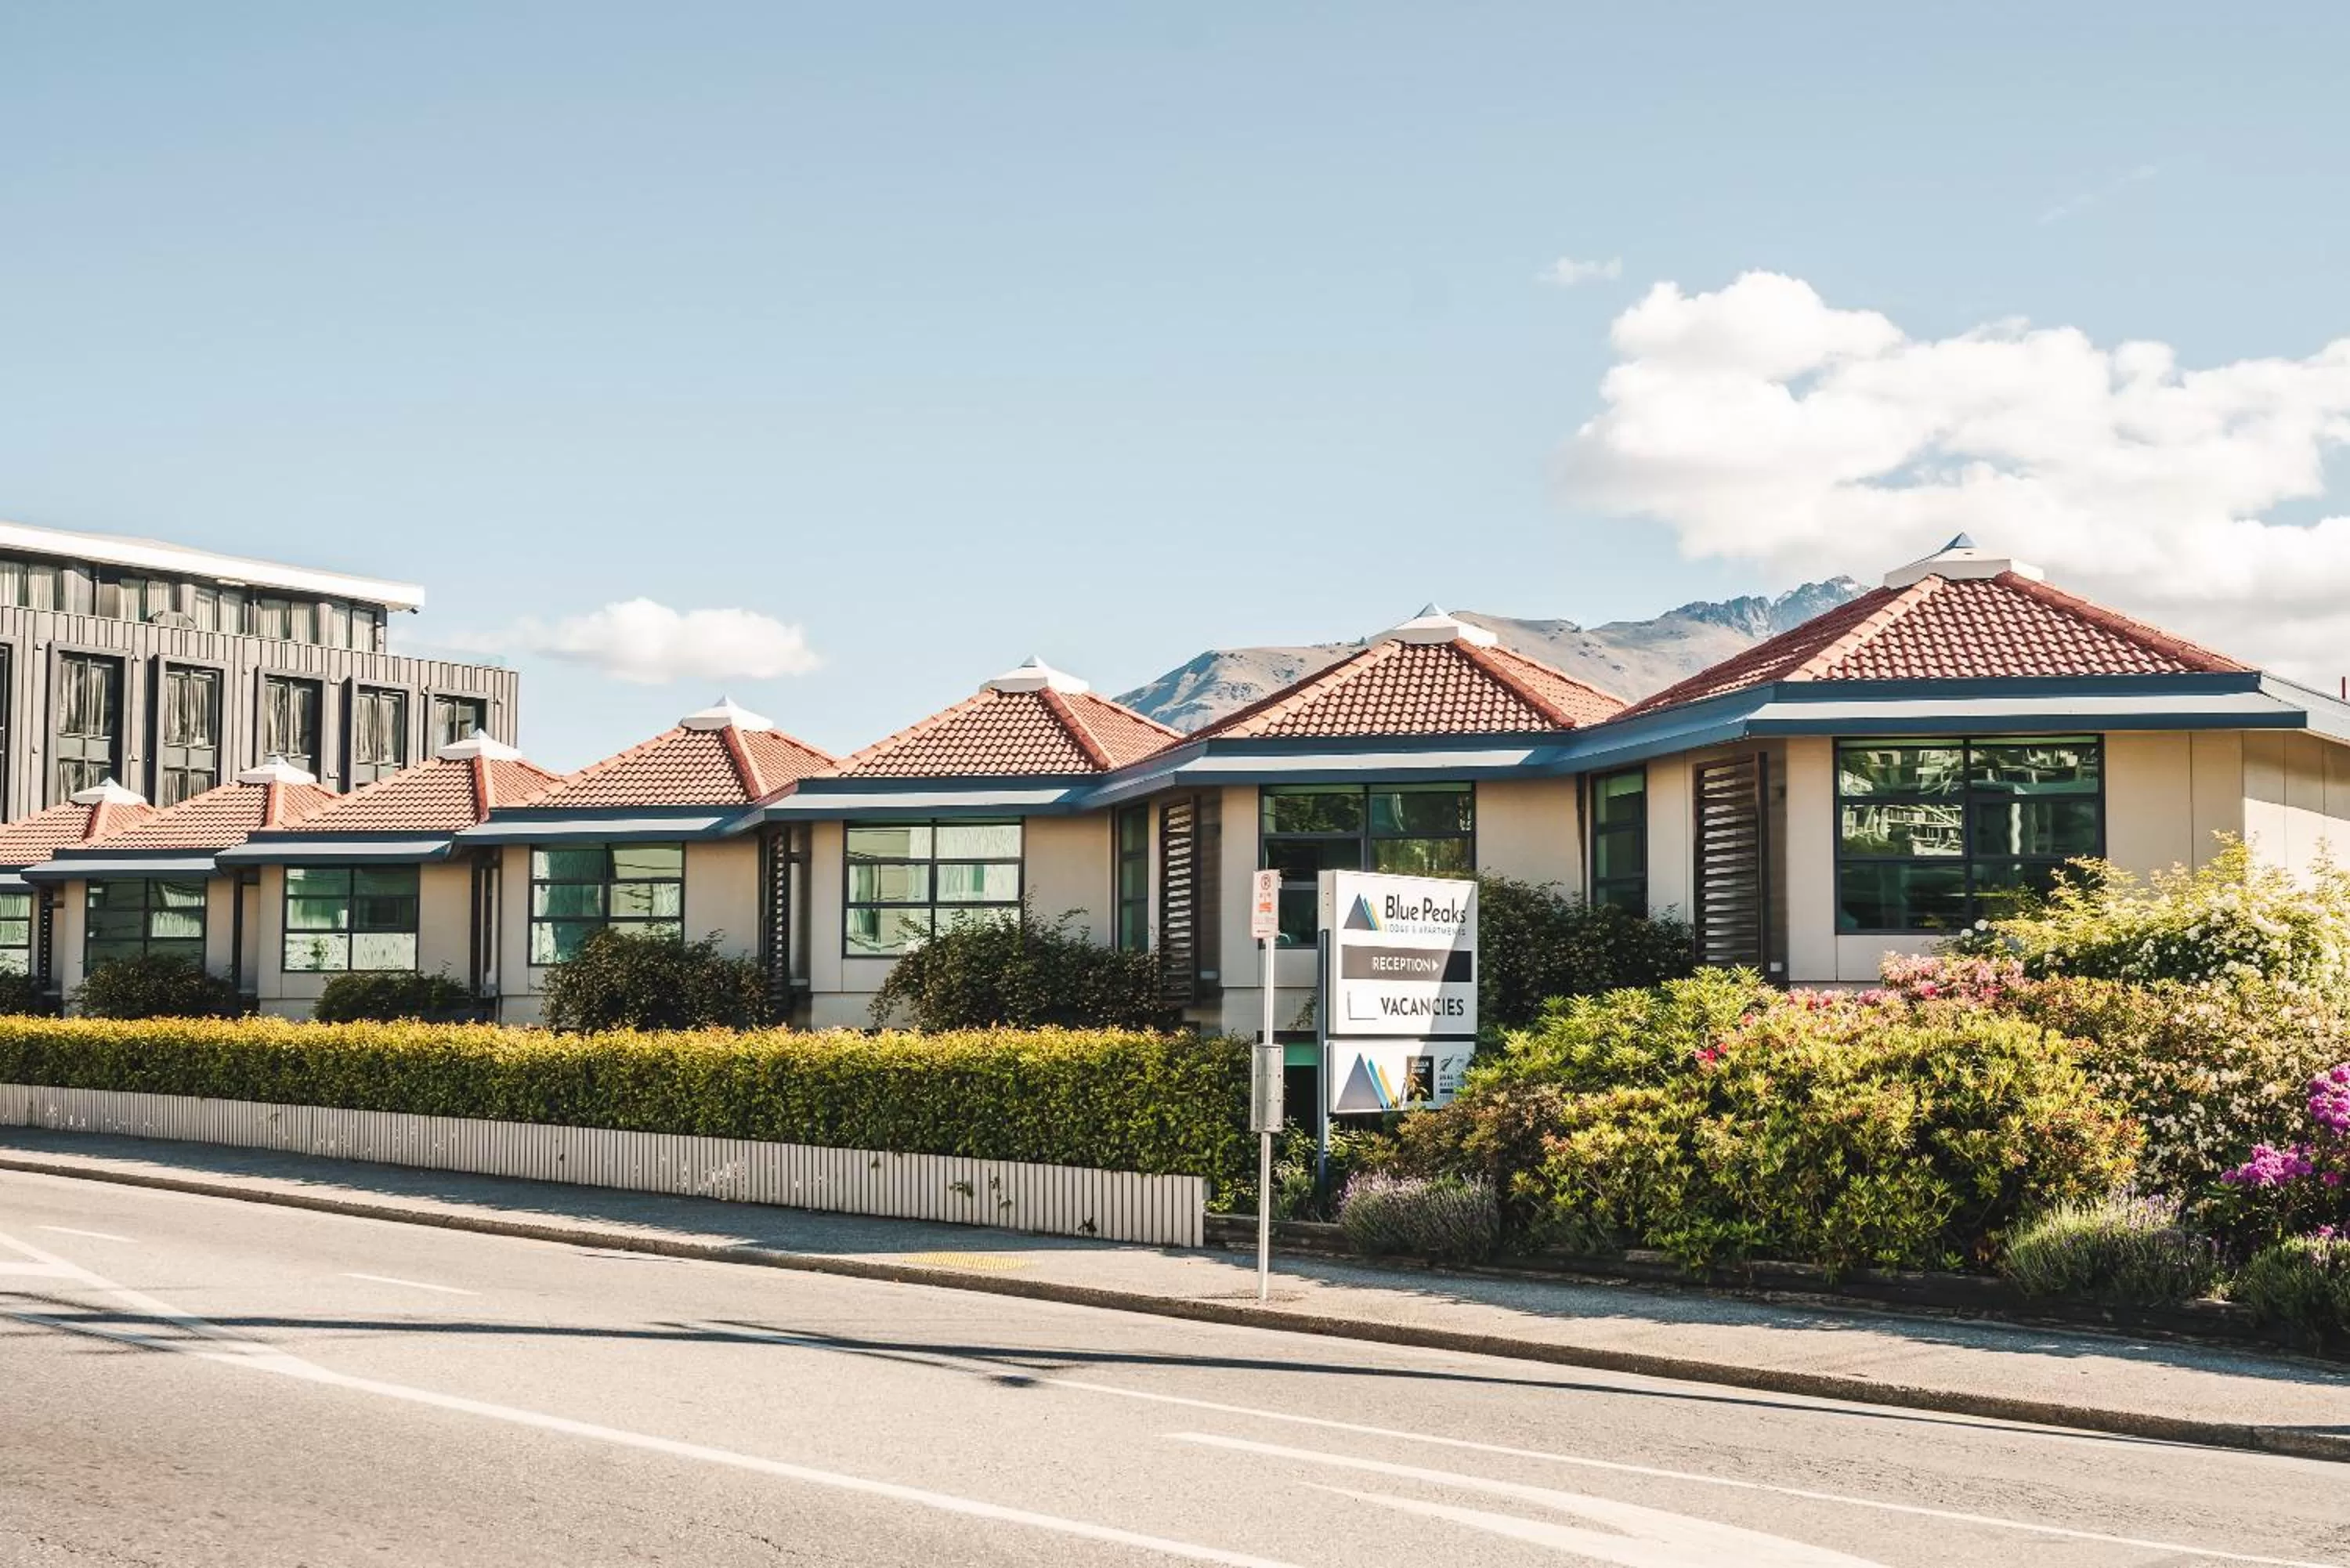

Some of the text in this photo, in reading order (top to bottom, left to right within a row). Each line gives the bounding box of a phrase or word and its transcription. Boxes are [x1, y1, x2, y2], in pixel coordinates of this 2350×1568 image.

[1386, 894, 1466, 923] Blue Peaks
[1372, 956, 1431, 971] RECEPTION
[1380, 997, 1464, 1016] VACANCIES
